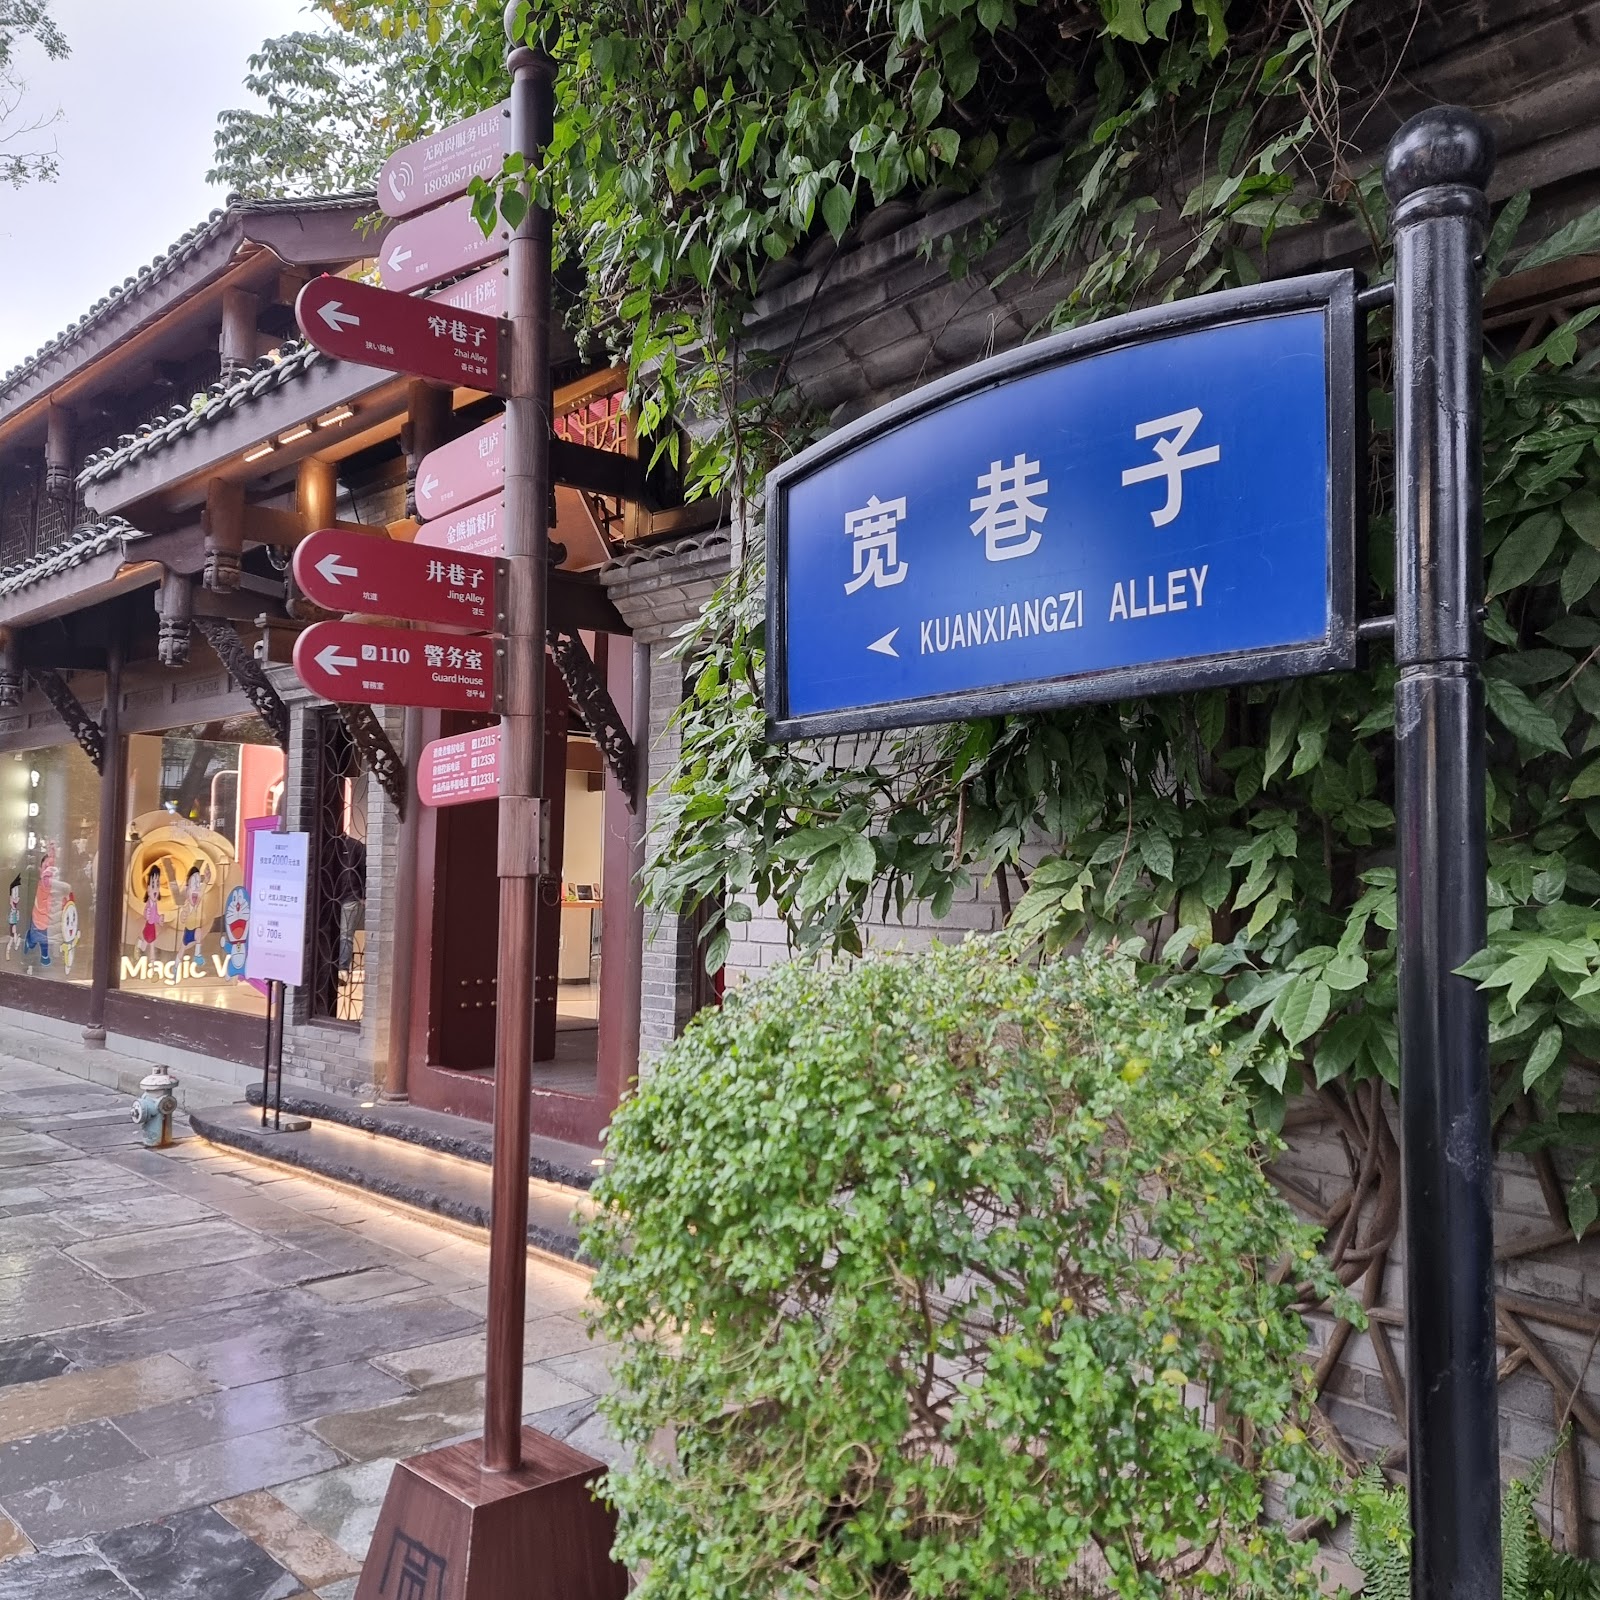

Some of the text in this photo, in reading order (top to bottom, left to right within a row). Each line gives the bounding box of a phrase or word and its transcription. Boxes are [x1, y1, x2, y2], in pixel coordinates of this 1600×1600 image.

[423, 116, 499, 163] 无障碍服务电话
[424, 155, 493, 195] 18030871607
[427, 315, 488, 347] 窄巷子
[453, 348, 488, 365] Zhai Alley
[843, 407, 1221, 596] 宽巷子
[446, 508, 497, 545] 金熊猫餐厅
[425, 560, 485, 589] 井巷子
[447, 590, 485, 606] Jing Alley
[919, 564, 1209, 656] KUANXIANGZI ALLEY
[380, 647, 410, 664] 110
[424, 644, 483, 671] 警务室
[431, 672, 484, 686] Guard House
[477, 734, 496, 749] 12315
[477, 753, 496, 768] 12358
[476, 772, 495, 786] 12331
[120, 954, 207, 986] Magic
